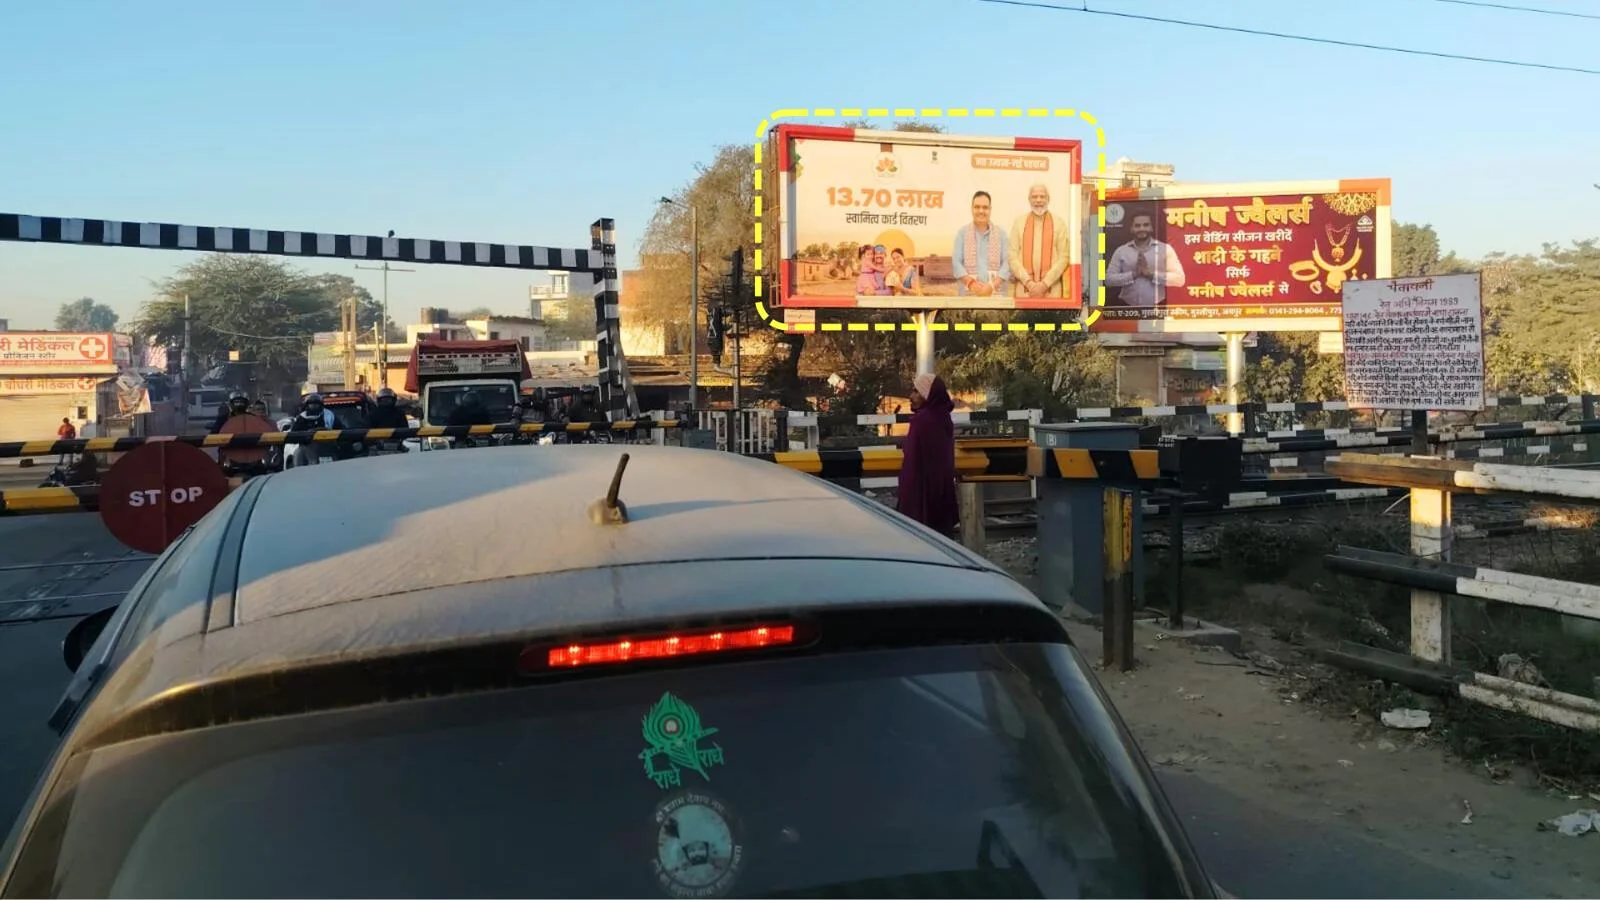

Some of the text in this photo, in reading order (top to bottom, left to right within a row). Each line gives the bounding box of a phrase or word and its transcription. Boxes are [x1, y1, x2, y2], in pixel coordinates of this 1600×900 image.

[826, 186, 944, 209] 13.70 लाख
[845, 211, 927, 226] स्वामित्व कार्ड वितरण
[1163, 196, 1314, 228] मनीष ज्वेलर्स
[1184, 228, 1293, 245] इस वेडिंग सीजन खरीदें
[1193, 244, 1283, 265] शादी के गहने
[1226, 265, 1251, 279] सिर्फ
[1187, 280, 1289, 298] मनीष ज्वेलर्स से
[18, 337, 76, 351] मेडिकल
[38, 377, 75, 390] मेडिकल
[699, 741, 725, 766] राधे
[653, 764, 681, 788] राधे
